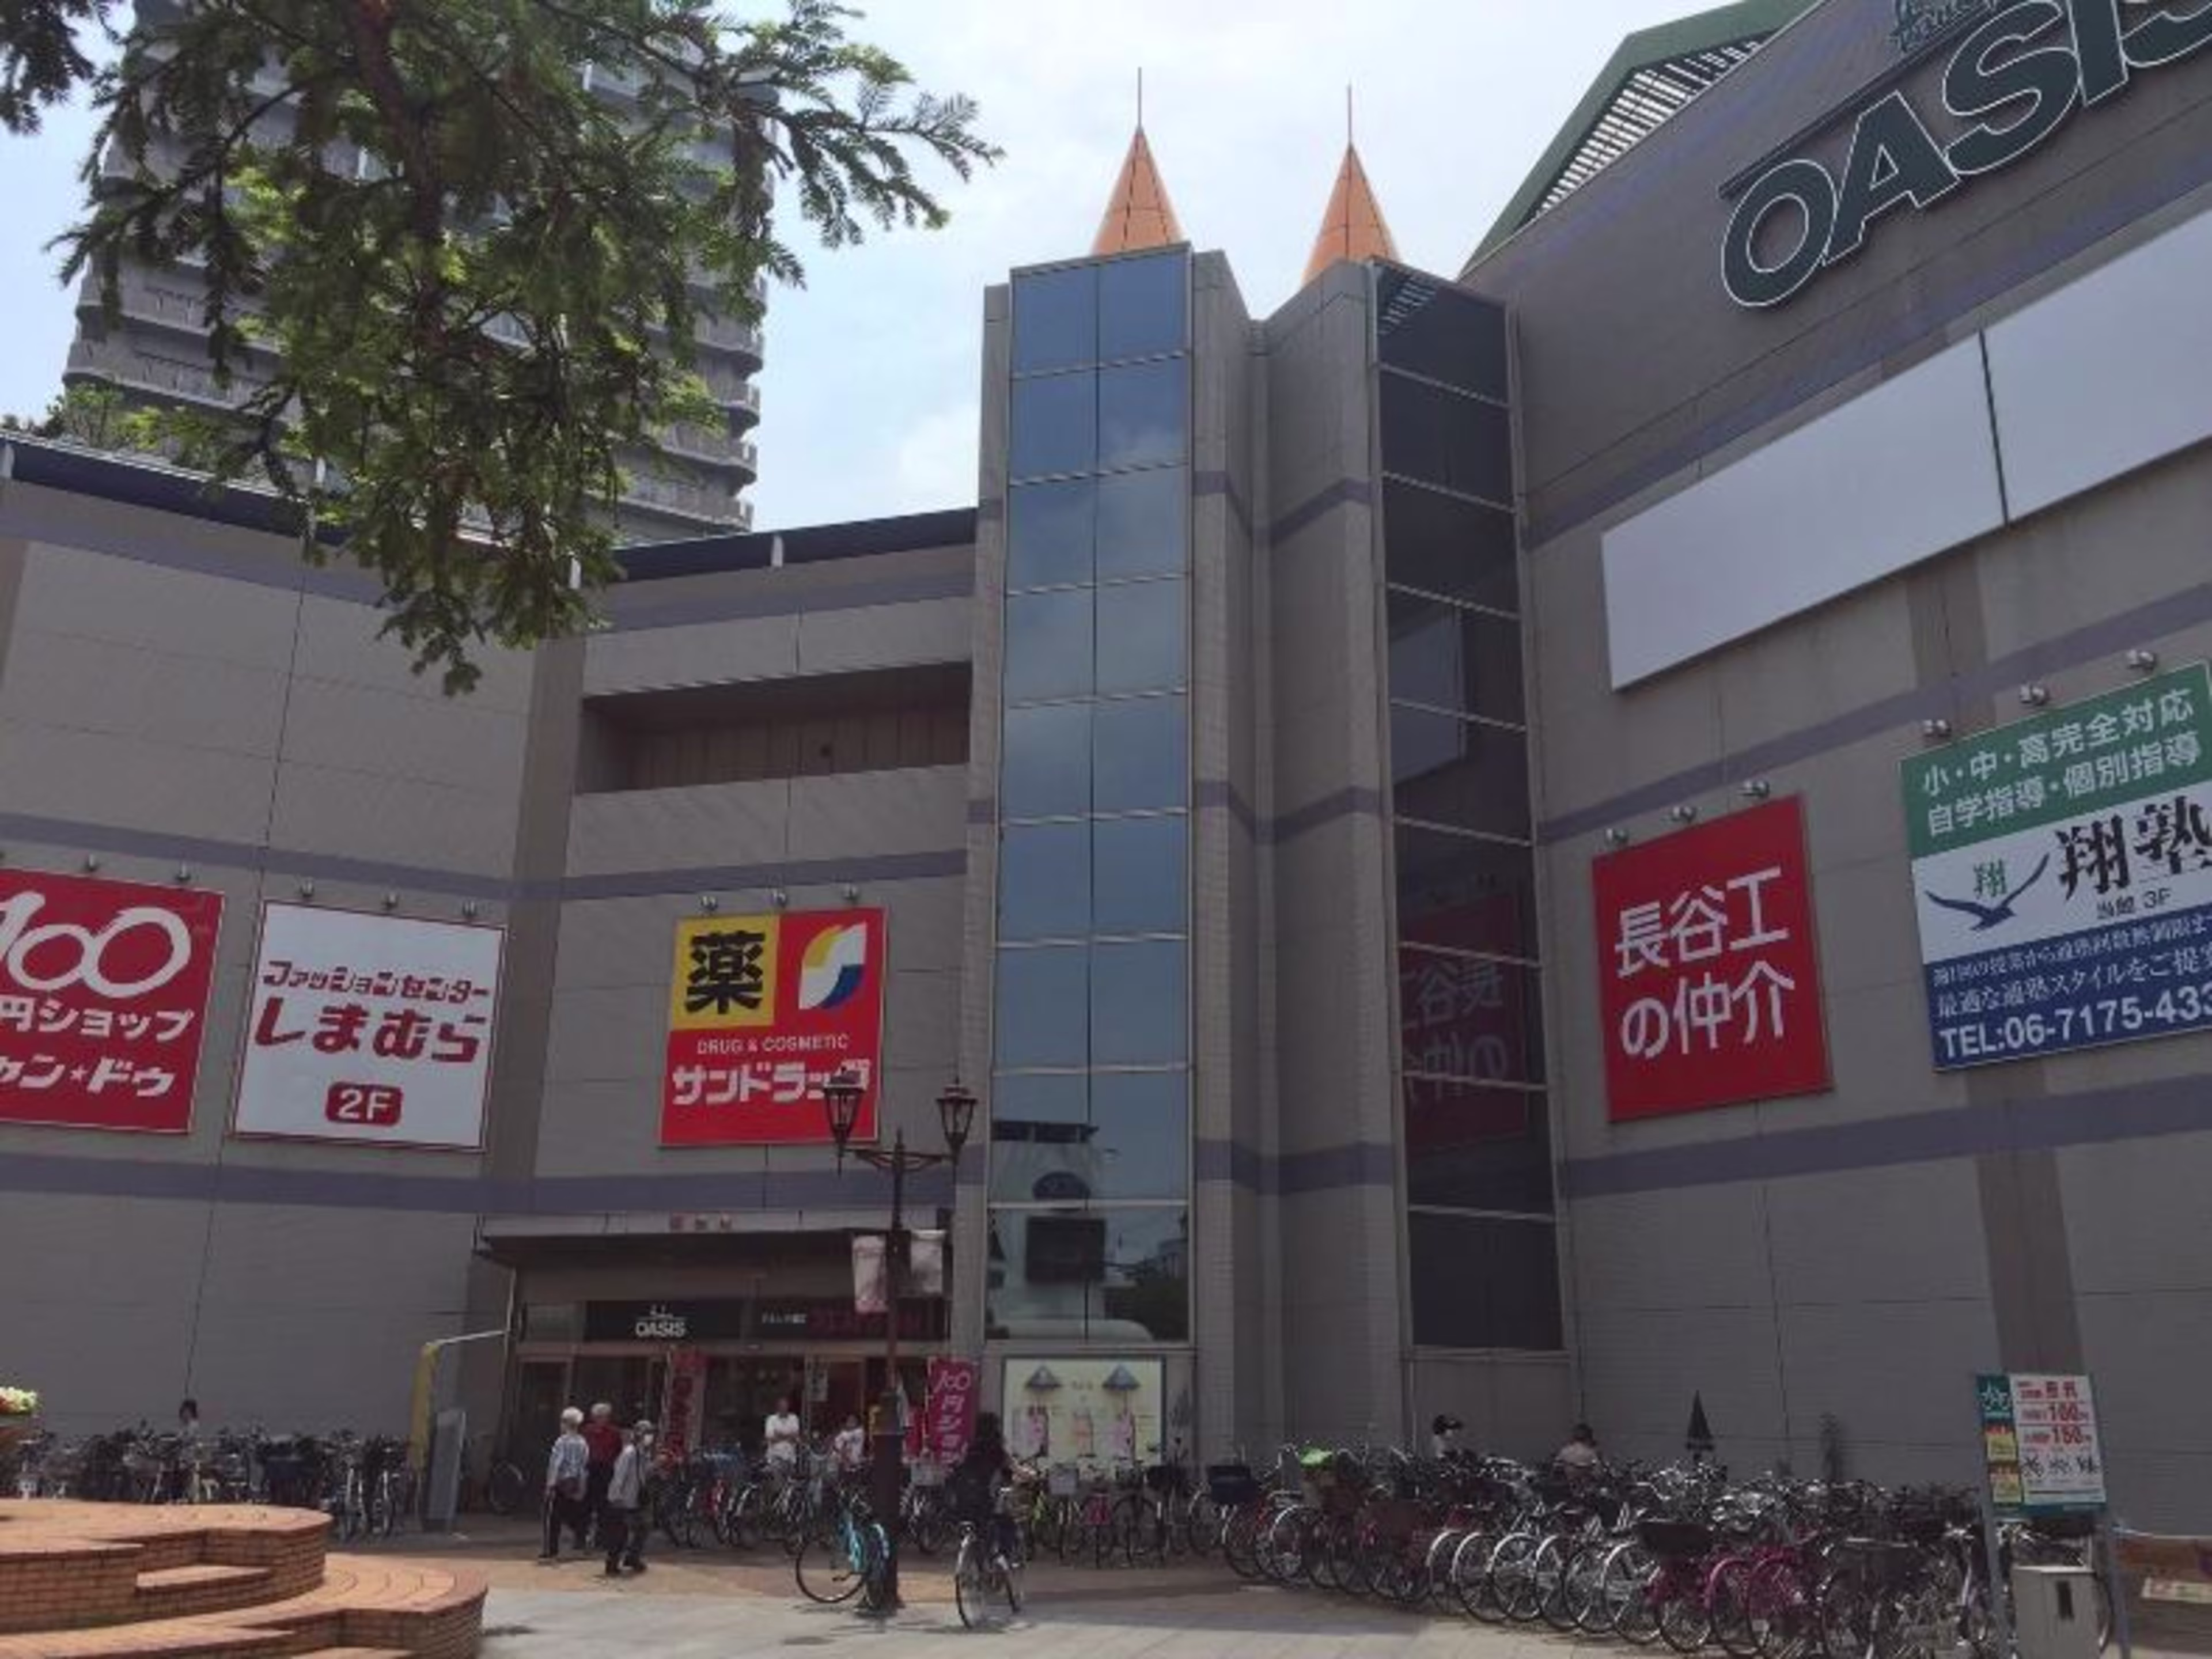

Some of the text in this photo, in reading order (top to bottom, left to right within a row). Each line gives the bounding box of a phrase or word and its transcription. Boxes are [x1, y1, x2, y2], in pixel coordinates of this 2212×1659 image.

[1615, 867, 1789, 978] 長谷工
[2143, 888, 2172, 909] 3F
[263, 960, 489, 1003] ファッションセンター
[685, 930, 766, 1014] 薬
[255, 997, 487, 1063] しまむら
[1620, 960, 1796, 1058] の仲介
[696, 1039, 743, 1055] DRUG
[762, 1033, 849, 1052] COSMETIC
[338, 1088, 392, 1120] 2F
